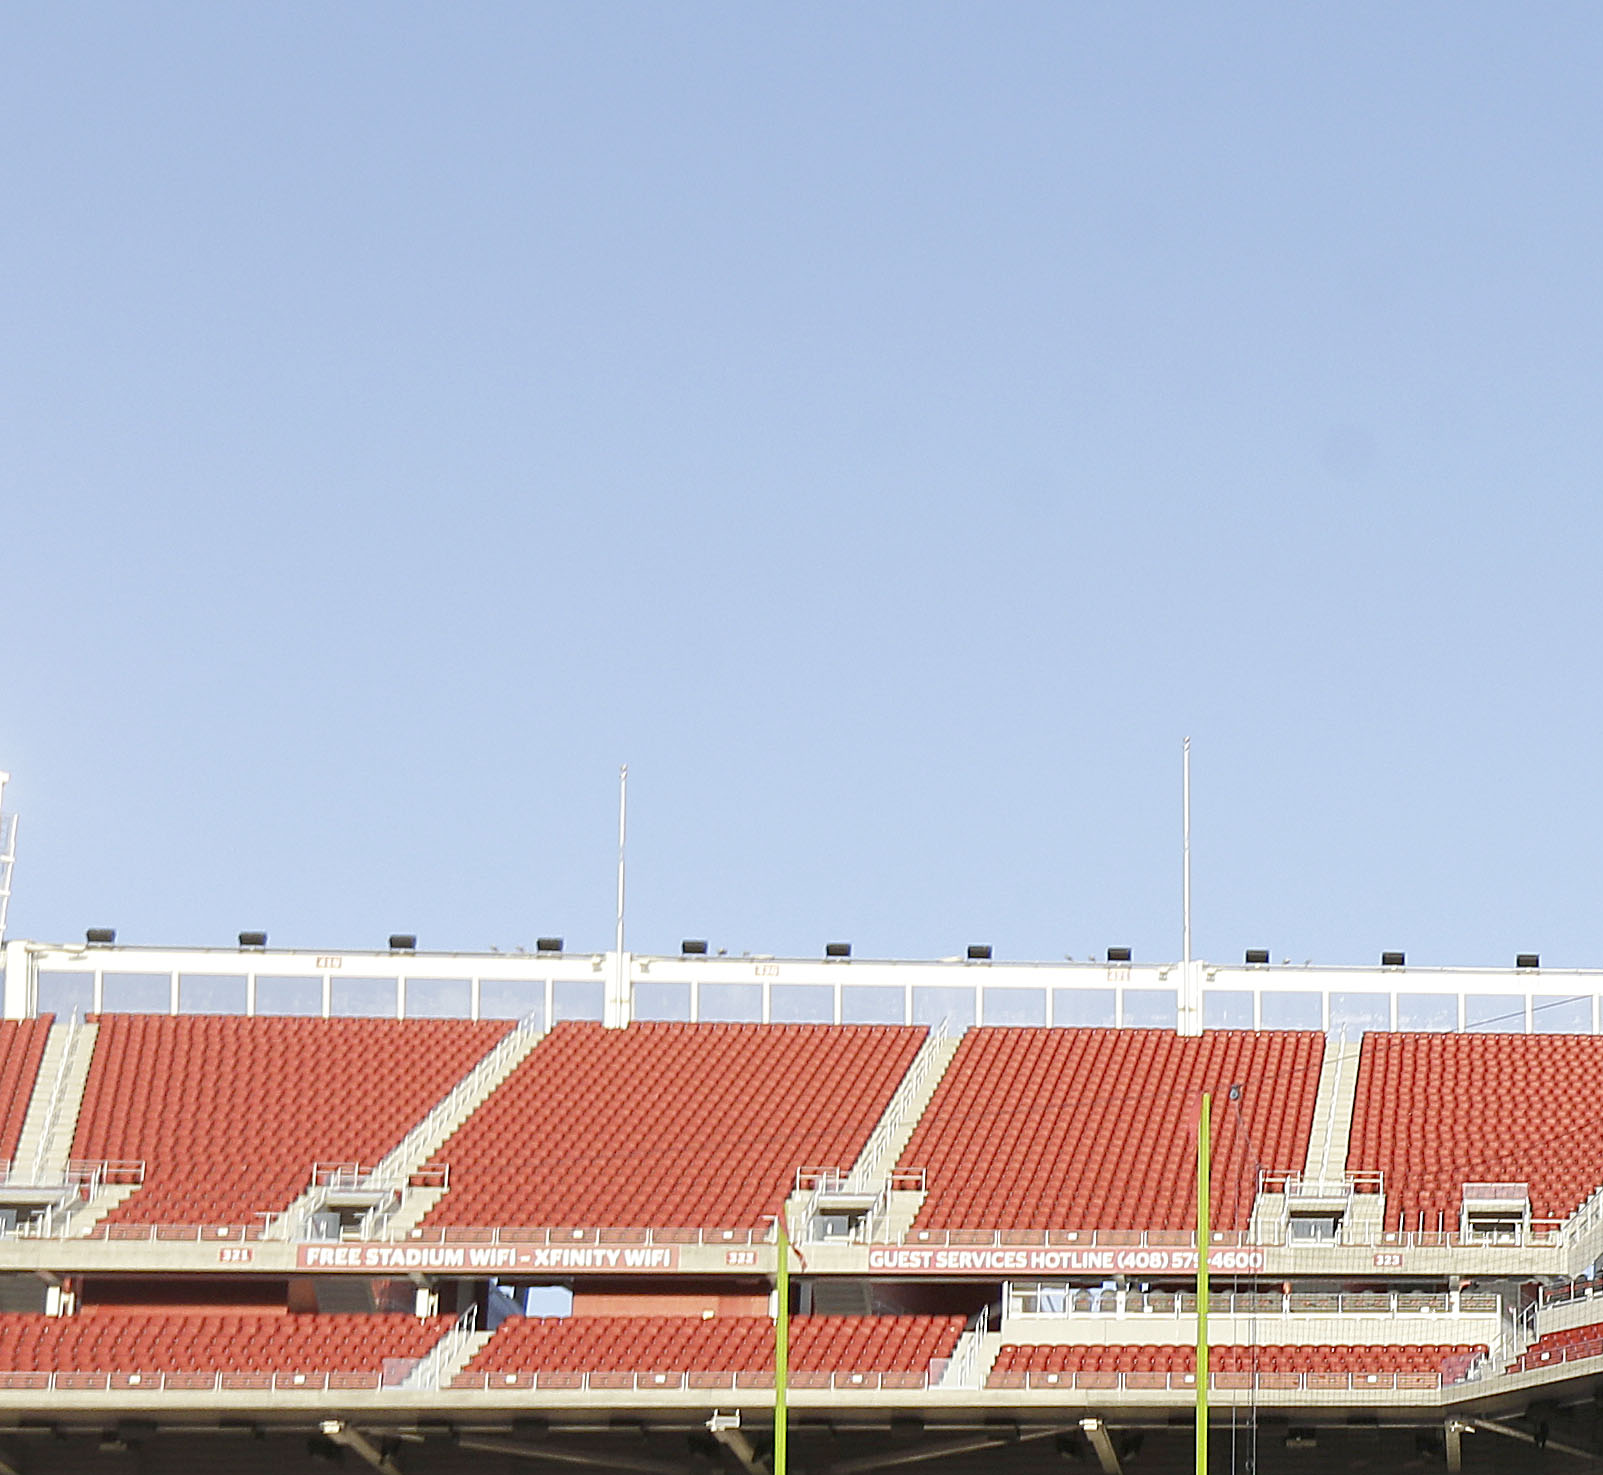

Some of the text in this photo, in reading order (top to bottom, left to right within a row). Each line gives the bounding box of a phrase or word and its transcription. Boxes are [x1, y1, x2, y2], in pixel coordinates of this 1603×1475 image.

[306, 1248, 362, 1267] FREE
[365, 1248, 464, 1267] STADIUM
[534, 1248, 620, 1267] XFINITY
[870, 1250, 932, 1269] GUEST
[936, 1250, 1027, 1269] SERVICES
[1031, 1250, 1114, 1270] HOTLINE
[1117, 1250, 1168, 1271] (408)
